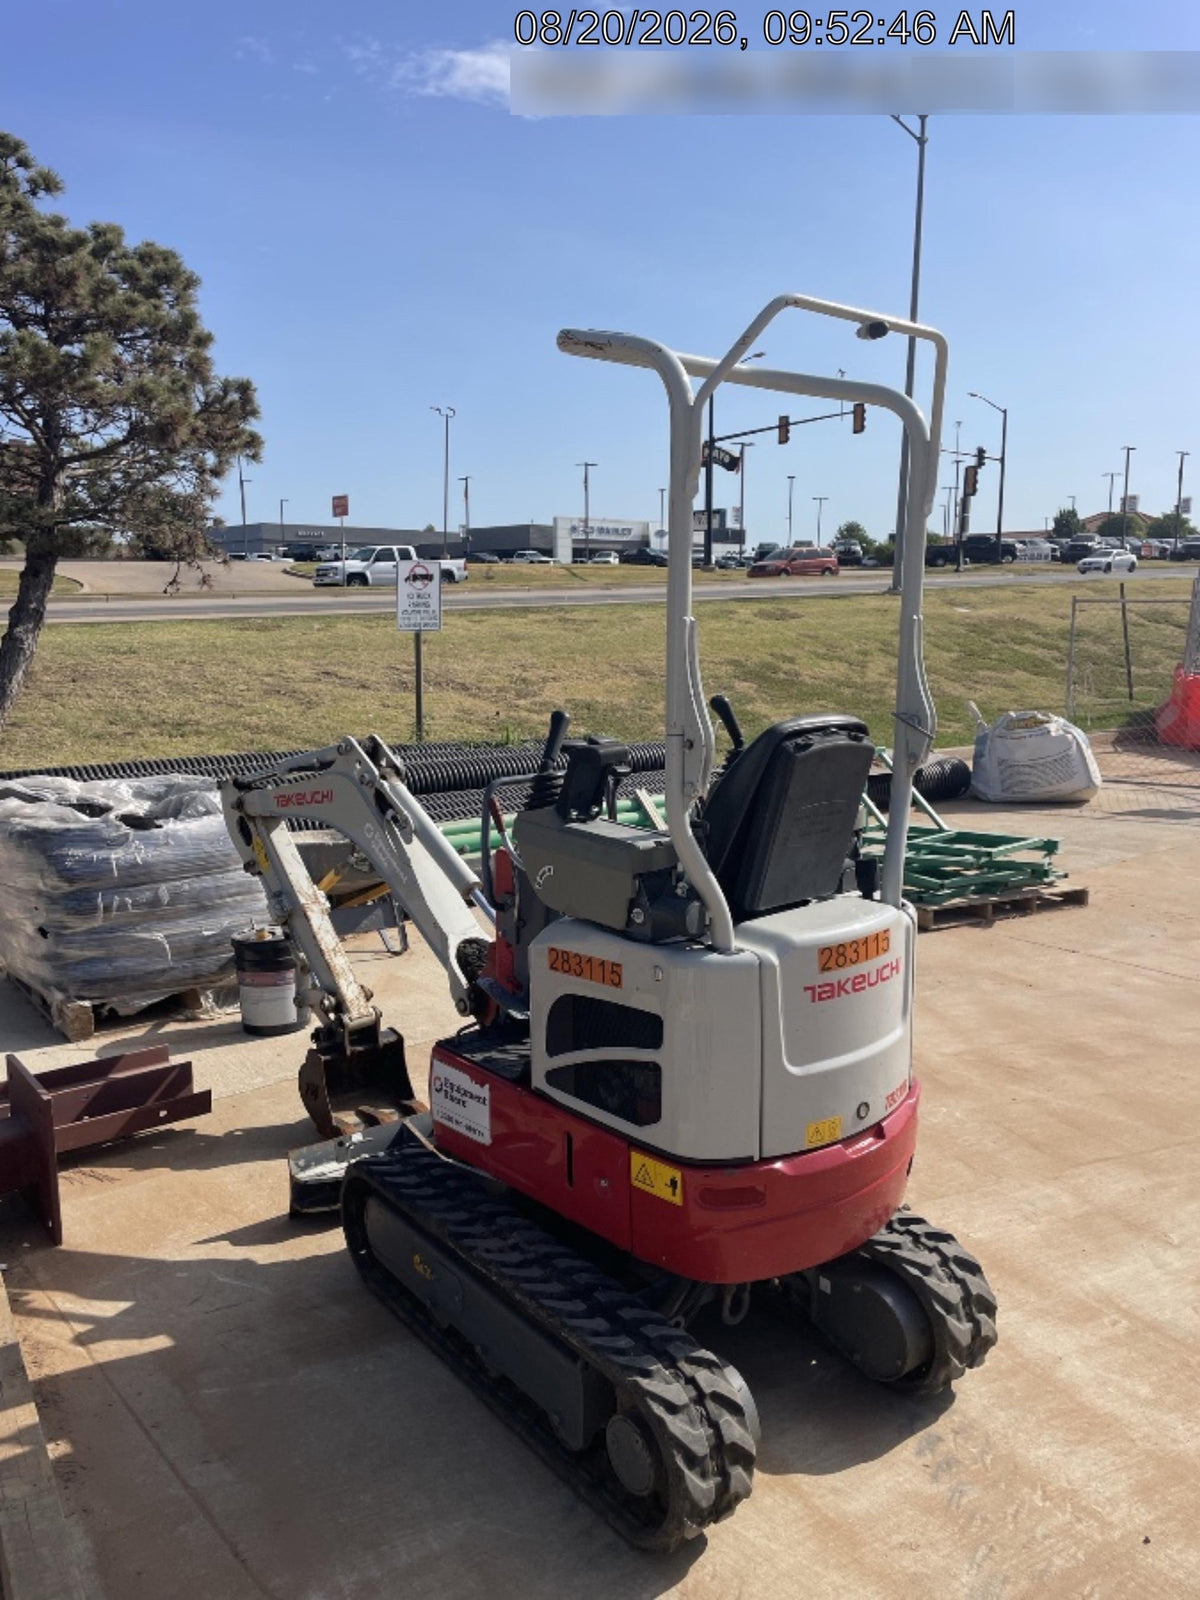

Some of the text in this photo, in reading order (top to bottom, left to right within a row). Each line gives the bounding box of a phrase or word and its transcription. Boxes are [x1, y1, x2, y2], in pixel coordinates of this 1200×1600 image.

[273, 789, 334, 809] TAKEUCHI
[548, 947, 623, 988] 283115
[821, 928, 890, 972] 283115
